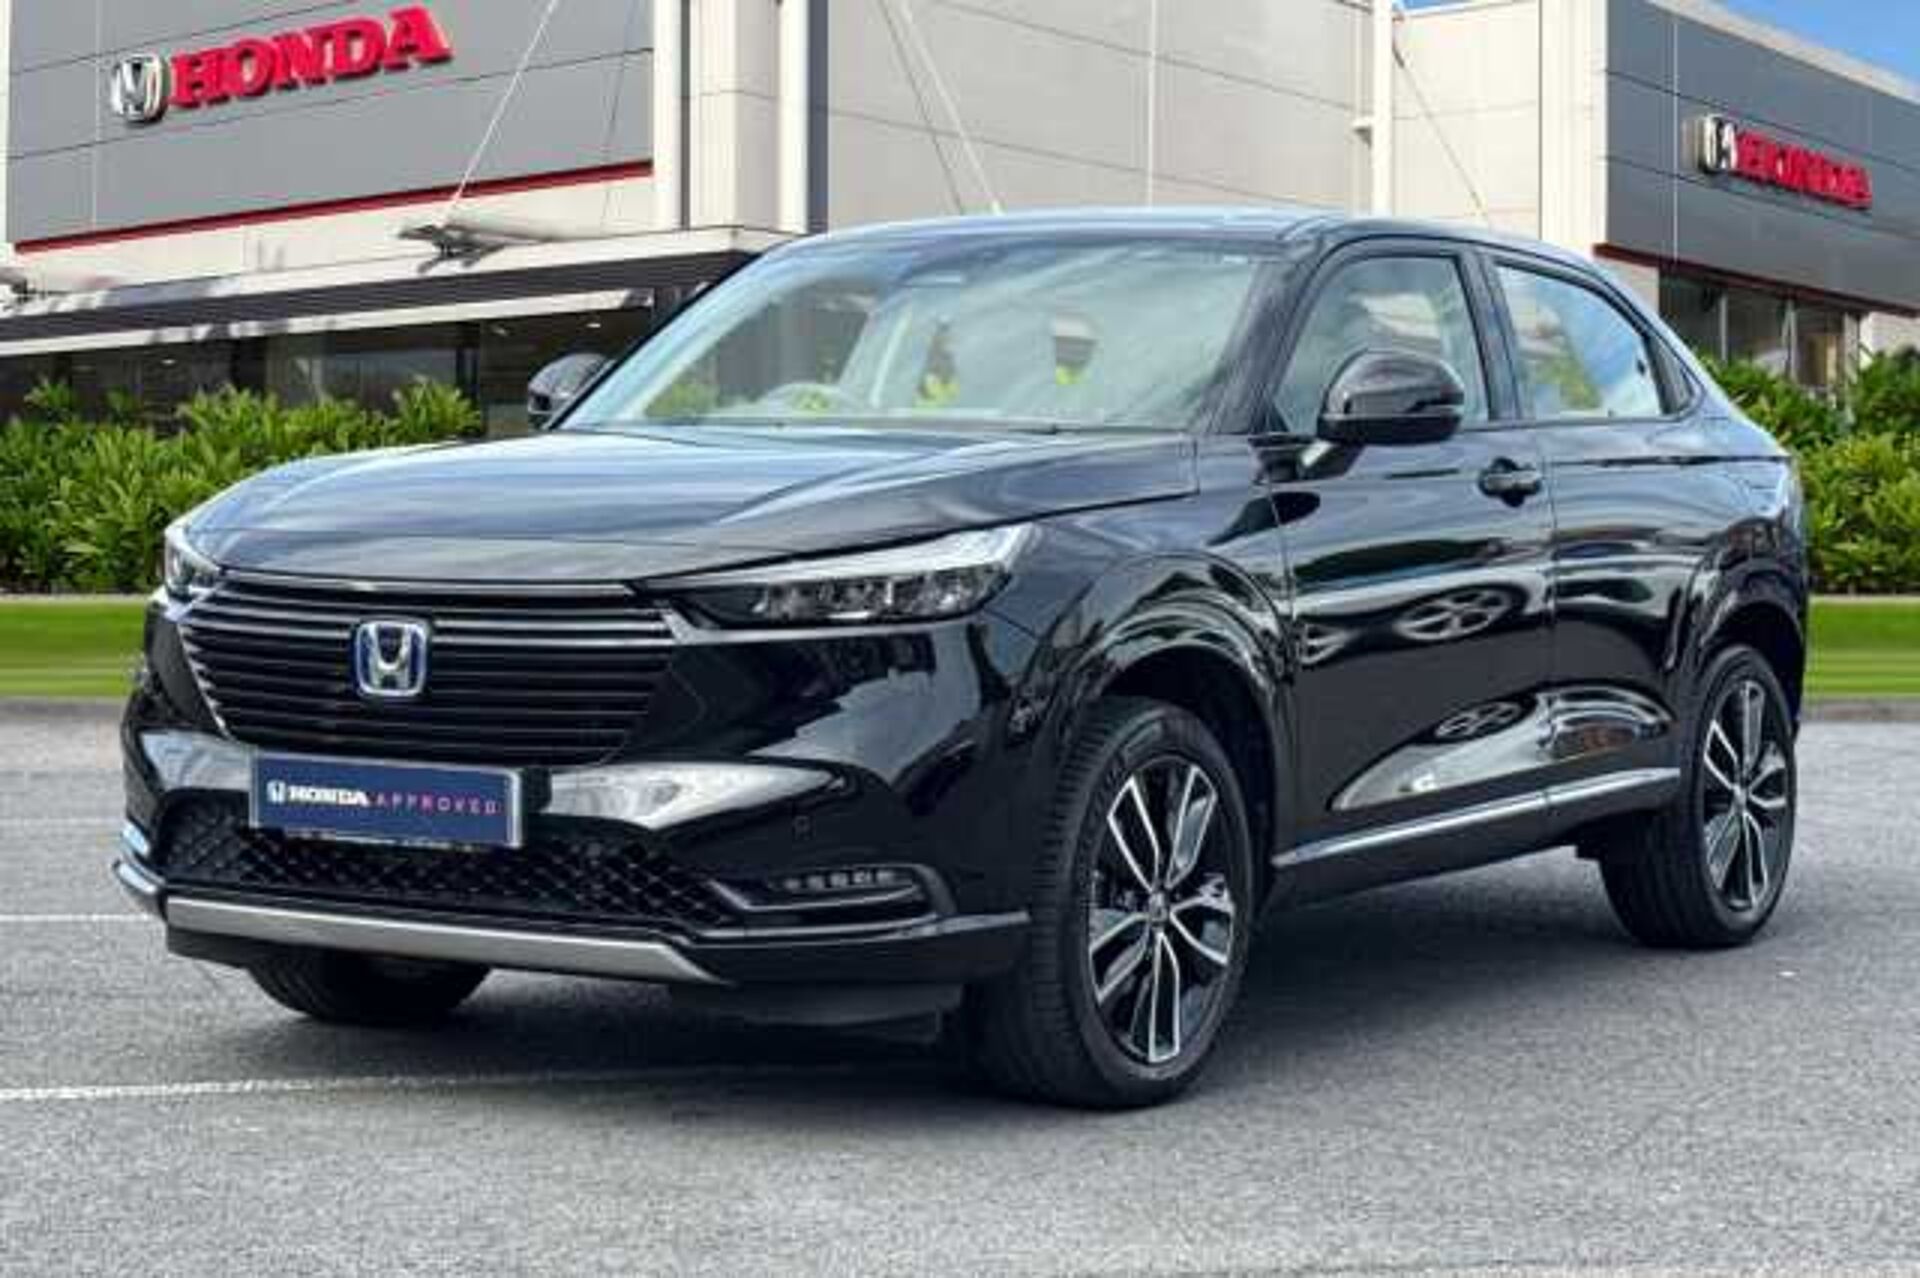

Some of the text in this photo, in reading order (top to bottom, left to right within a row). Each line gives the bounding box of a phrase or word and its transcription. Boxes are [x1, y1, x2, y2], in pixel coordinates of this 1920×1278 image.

[169, 5, 453, 107] HONDA
[288, 784, 498, 815] HONDA APPROVED
